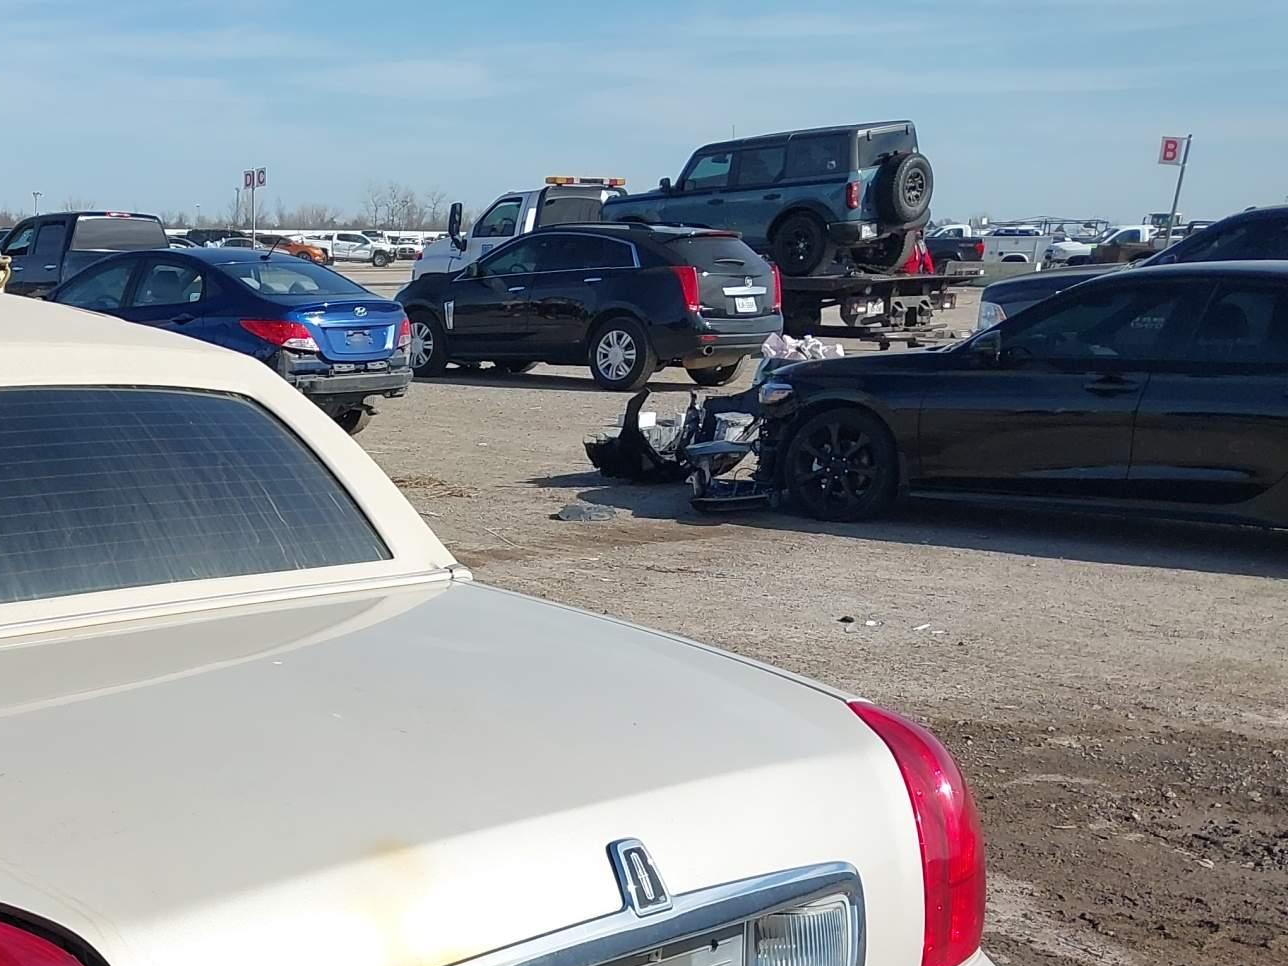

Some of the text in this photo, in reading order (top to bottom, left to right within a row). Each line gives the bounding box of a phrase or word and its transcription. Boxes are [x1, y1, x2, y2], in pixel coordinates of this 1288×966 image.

[1163, 140, 1178, 161] B
[244, 172, 253, 187] D
[258, 170, 265, 185] C
